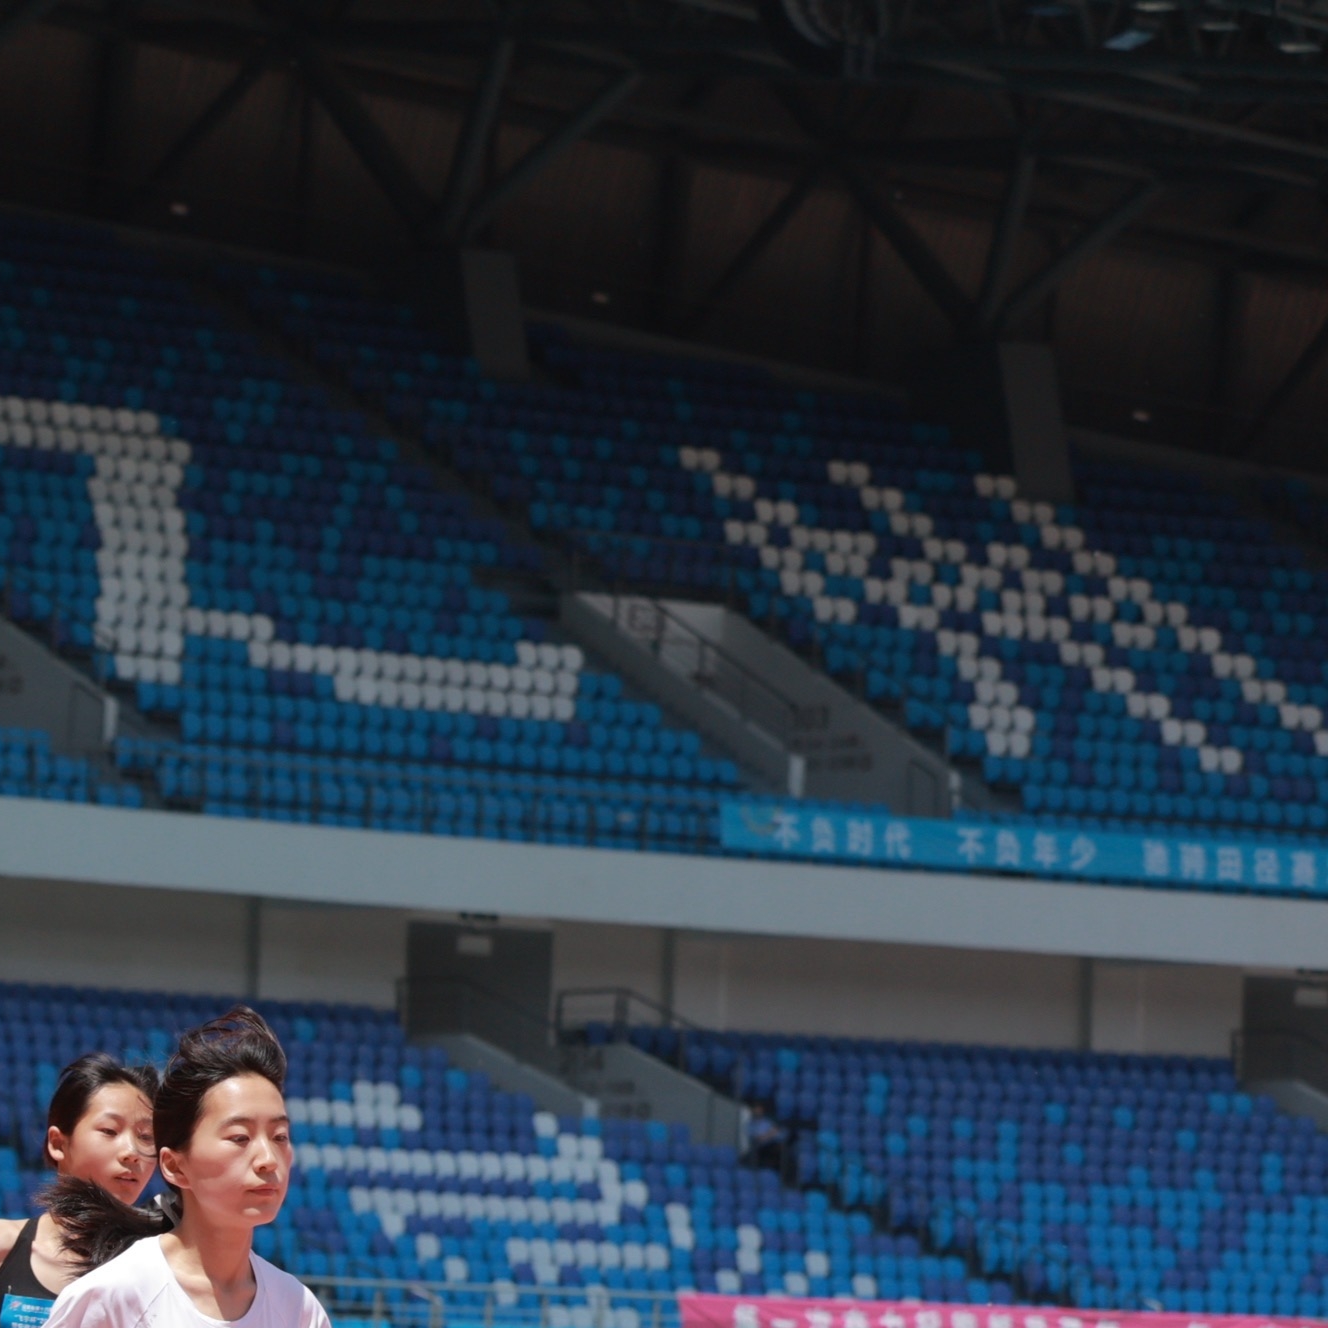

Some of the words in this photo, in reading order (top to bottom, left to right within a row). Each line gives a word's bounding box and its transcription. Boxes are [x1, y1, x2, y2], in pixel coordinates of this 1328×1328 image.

[1141, 838, 1328, 889] 驰骋田径赛
